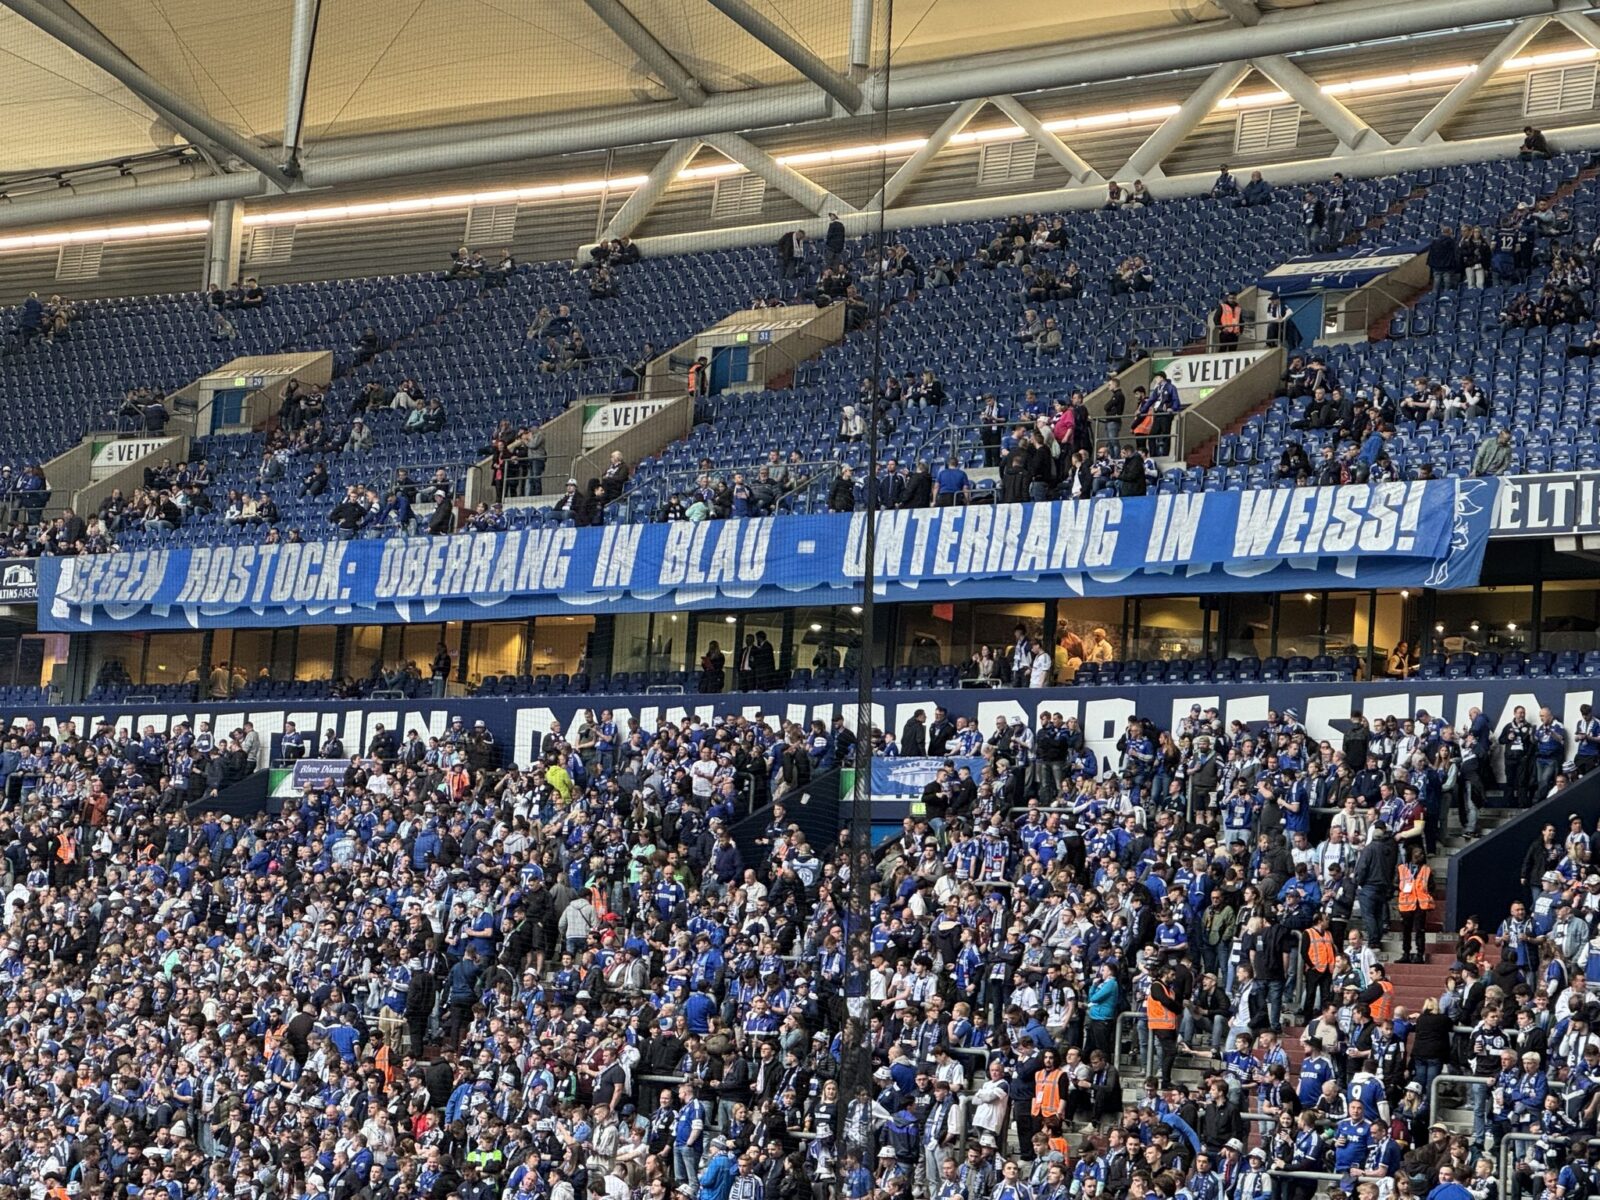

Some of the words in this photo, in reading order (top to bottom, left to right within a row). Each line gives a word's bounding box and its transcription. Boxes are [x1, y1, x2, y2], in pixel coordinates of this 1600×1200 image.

[1501, 236, 1513, 250] 12
[760, 331, 769, 340] 31
[1497, 479, 1600, 529] ELTI
[69, 551, 170, 603] GEGEN
[375, 527, 578, 597] OBERRANG
[593, 523, 644, 587] IN
[659, 516, 774, 585] BLAU
[842, 498, 1122, 577] UNTERRANG
[1145, 493, 1206, 562] IN
[1232, 481, 1428, 557] WEISS!
[1352, 1085, 1362, 1100] 9
